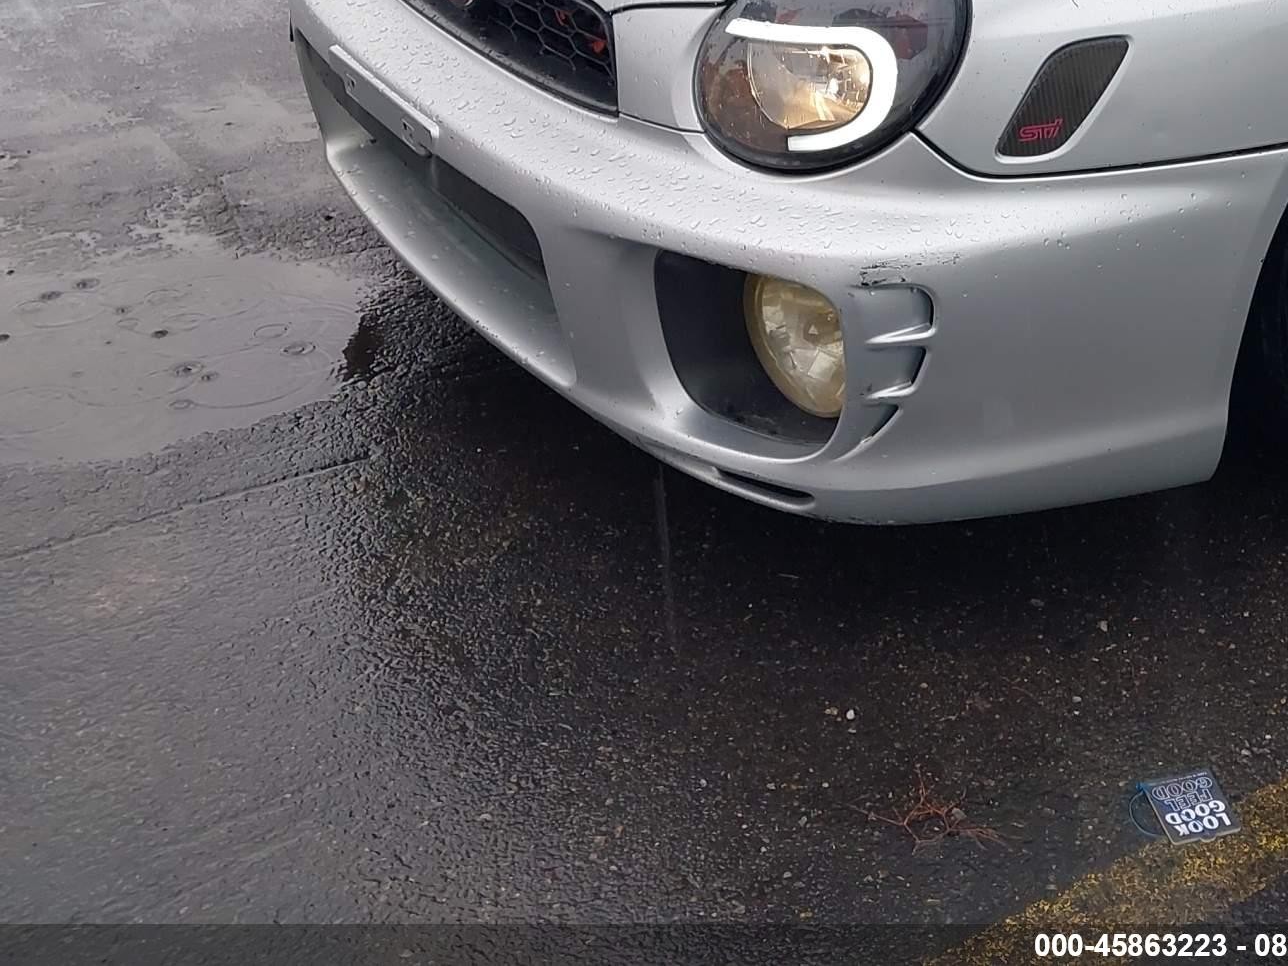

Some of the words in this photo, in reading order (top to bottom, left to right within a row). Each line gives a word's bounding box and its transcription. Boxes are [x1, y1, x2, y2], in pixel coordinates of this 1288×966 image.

[1151, 777, 1213, 800] GOOD
[1164, 788, 1213, 811] FEEL
[1165, 800, 1226, 825] GOOD
[1173, 812, 1231, 836] LOOK
